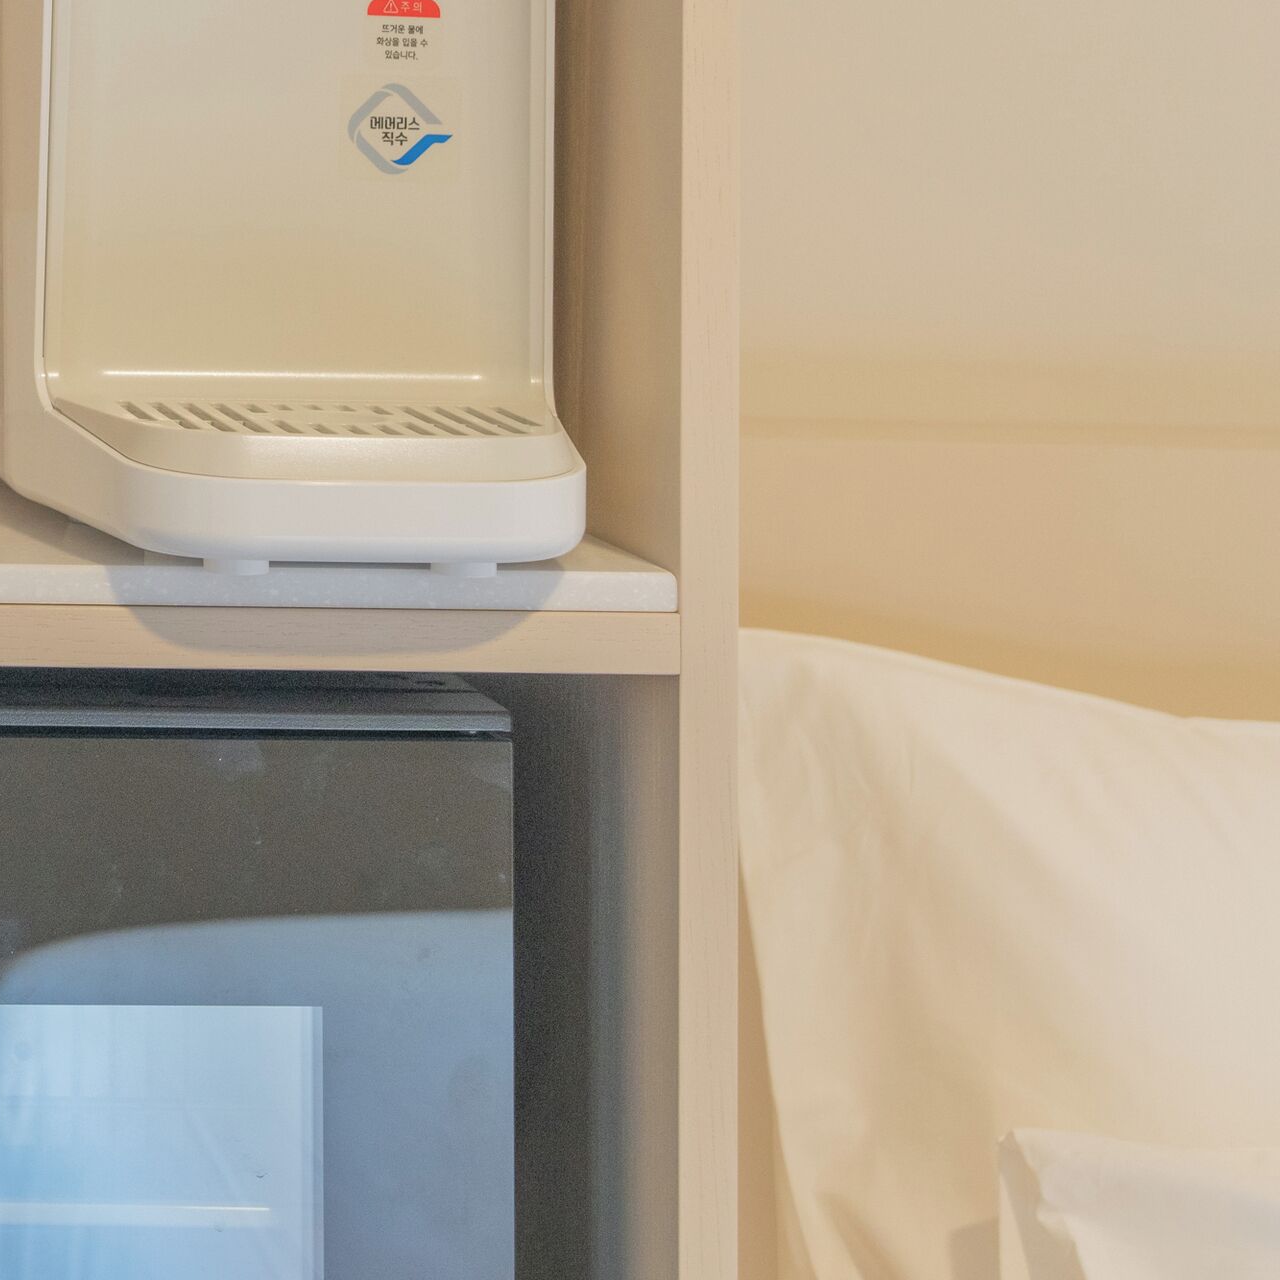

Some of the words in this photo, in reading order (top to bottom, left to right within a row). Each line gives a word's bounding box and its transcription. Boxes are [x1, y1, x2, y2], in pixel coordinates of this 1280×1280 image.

[382, 24, 405, 34] 뜨거운
[408, 24, 424, 34] 물에
[376, 36, 399, 47] 화상을
[402, 37, 417, 47] 입을
[420, 38, 428, 48] 수
[384, 49, 418, 60] 있습니다.
[382, 131, 408, 146] 직수
